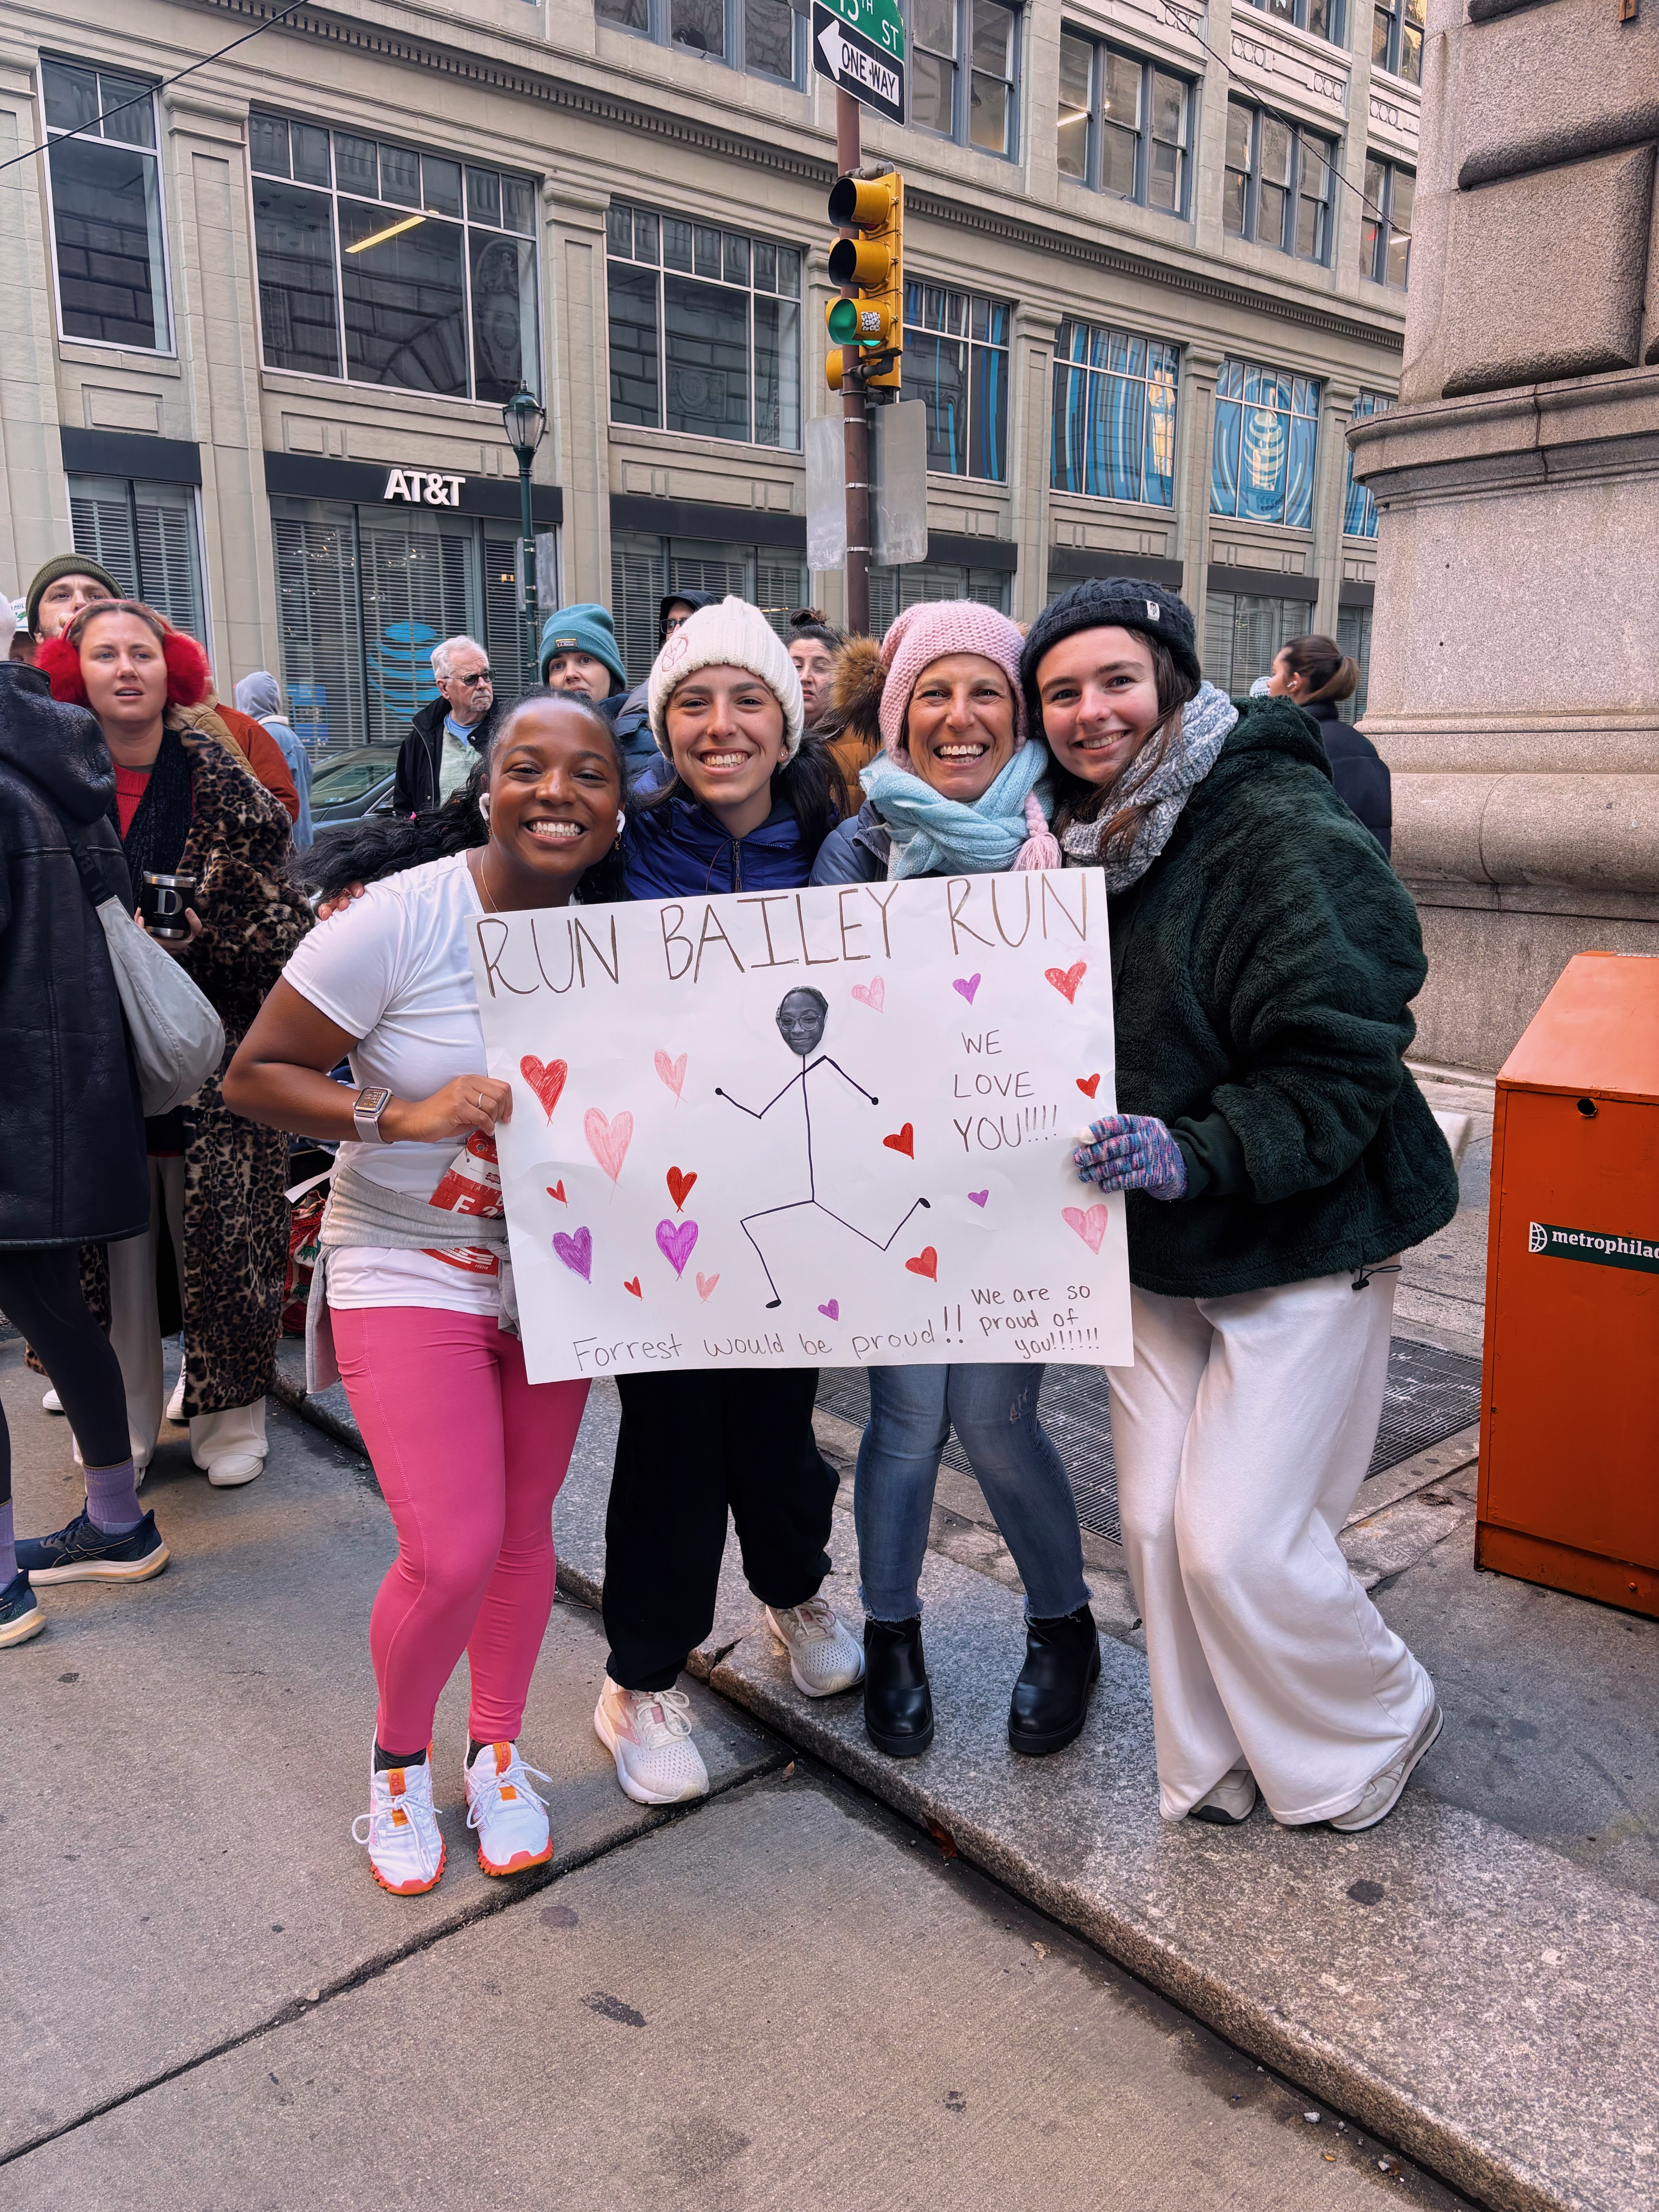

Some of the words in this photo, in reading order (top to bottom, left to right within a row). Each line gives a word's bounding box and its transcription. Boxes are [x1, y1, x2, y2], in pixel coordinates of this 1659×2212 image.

[882, 19, 899, 50] ST
[842, 43, 867, 81] ONE
[871, 62, 896, 99] WAY
[383, 469, 466, 507] AT&T
[154, 888, 182, 915] D
[476, 914, 619, 998] RUN
[660, 883, 899, 984] BAILEY
[946, 872, 1087, 956] RUN
[962, 1029, 1003, 1054] WE
[954, 1071, 1035, 1098] LOVE
[953, 1104, 1058, 1152] YOU!!!!
[970, 1288, 1005, 1305] We
[1013, 1288, 1050, 1303] are
[1067, 1285, 1091, 1300] so
[572, 1333, 683, 1371] Forrest
[703, 1333, 785, 1357] would
[799, 1333, 833, 1355] be
[852, 1304, 964, 1360] proud!!
[979, 1309, 1039, 1337] proud
[1053, 1308, 1079, 1328] of
